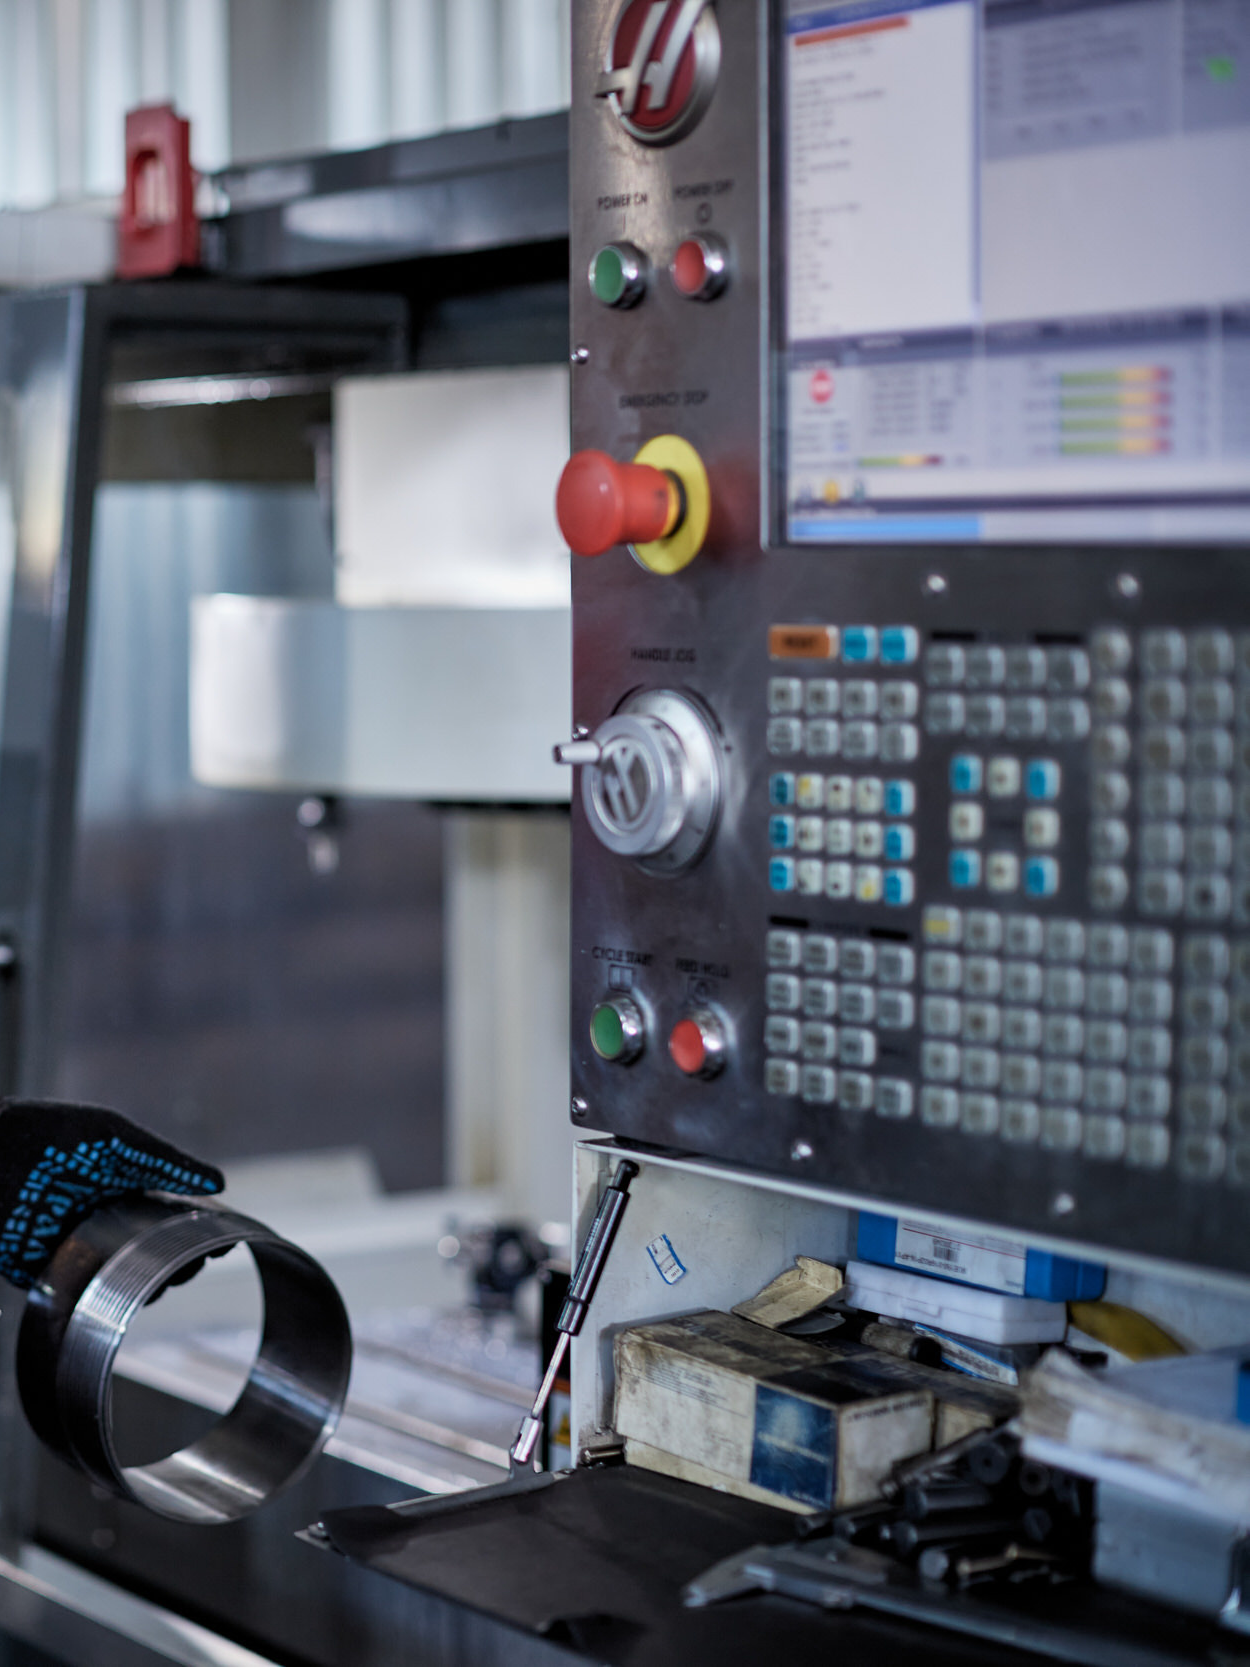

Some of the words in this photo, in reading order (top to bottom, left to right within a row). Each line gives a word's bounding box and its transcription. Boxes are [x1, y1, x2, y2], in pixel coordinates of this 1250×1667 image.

[597, 194, 631, 210] POWER
[633, 192, 648, 206] ON
[592, 946, 623, 962] CYCLE
